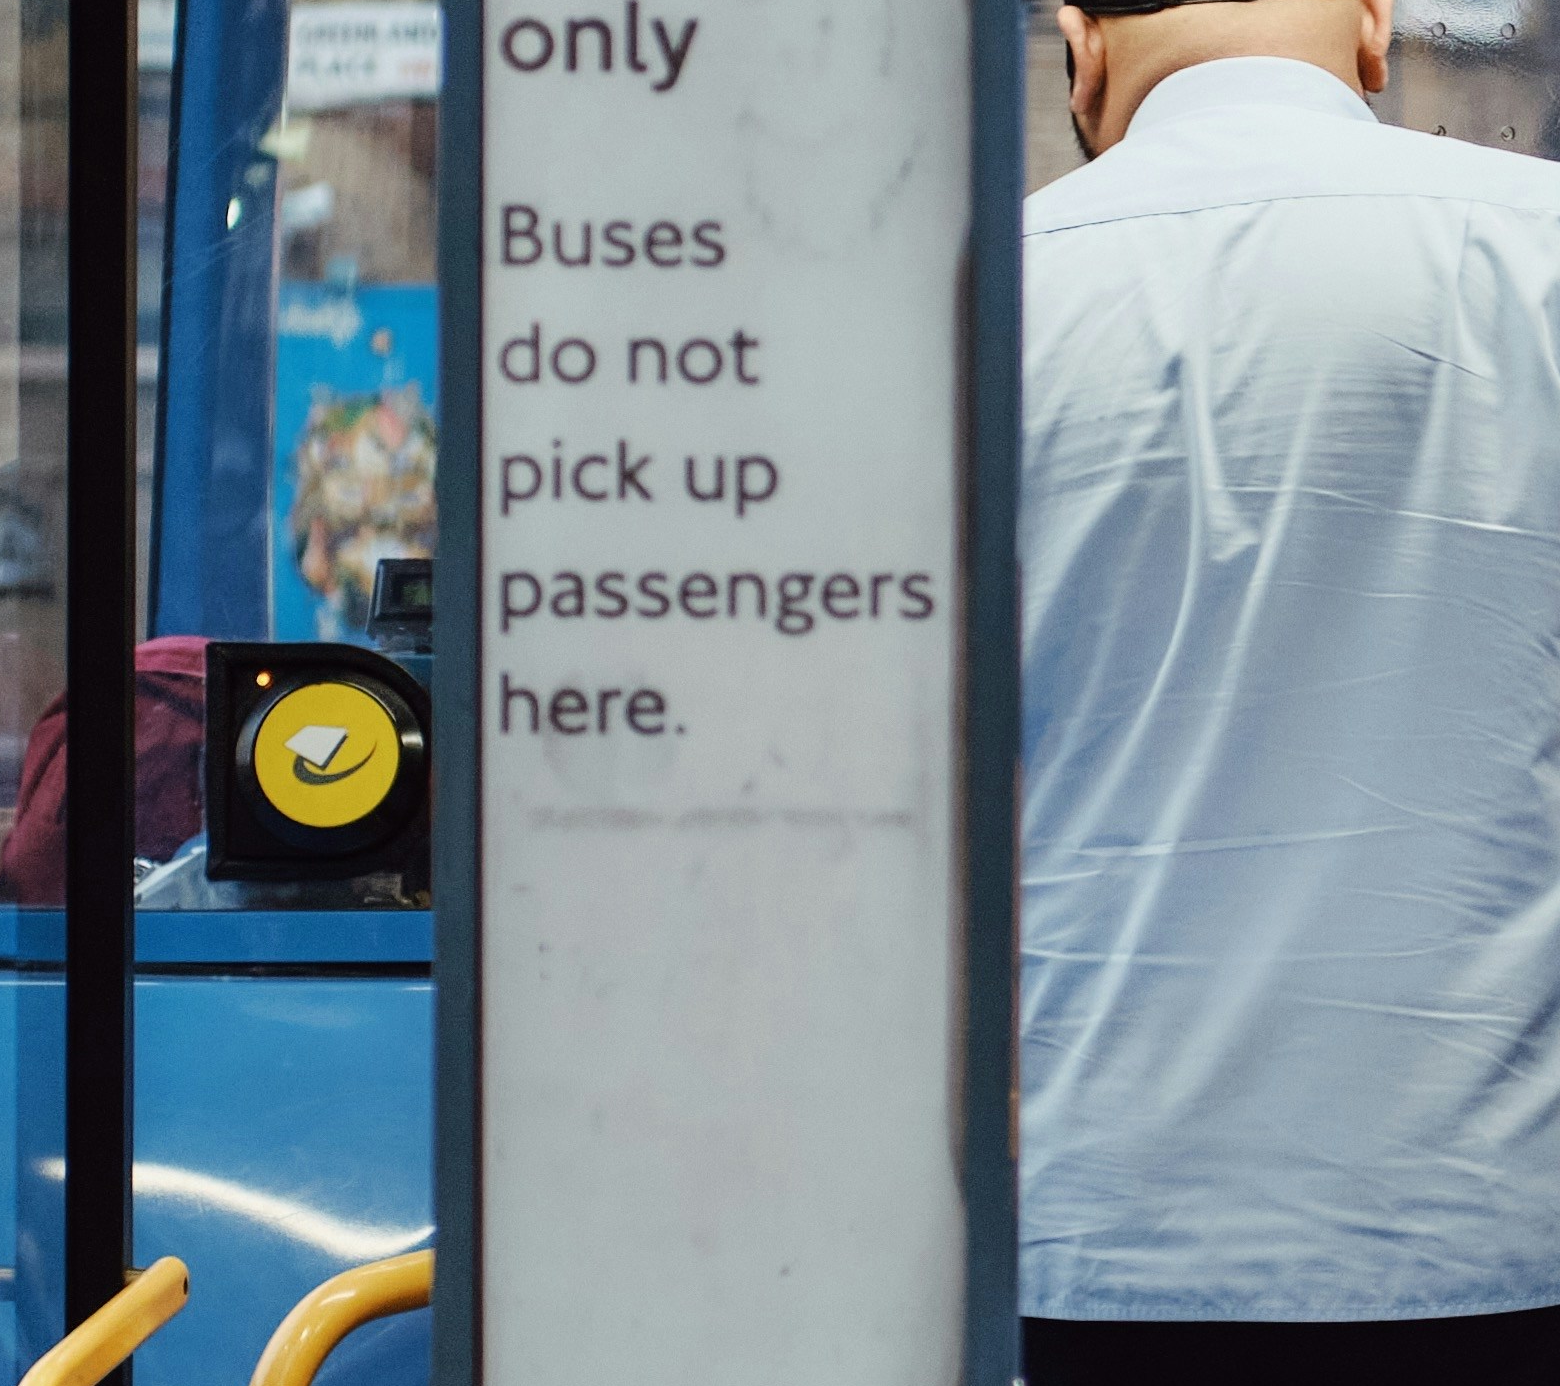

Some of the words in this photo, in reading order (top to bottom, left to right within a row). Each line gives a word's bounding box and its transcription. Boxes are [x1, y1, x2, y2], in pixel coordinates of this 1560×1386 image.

[500, 203, 727, 269] Buses
[498, 321, 598, 386] do
[627, 328, 761, 387] not
[499, 438, 654, 518] pick
[684, 454, 781, 519] up
[499, 570, 937, 637] passengers
[499, 671, 687, 737] here.
